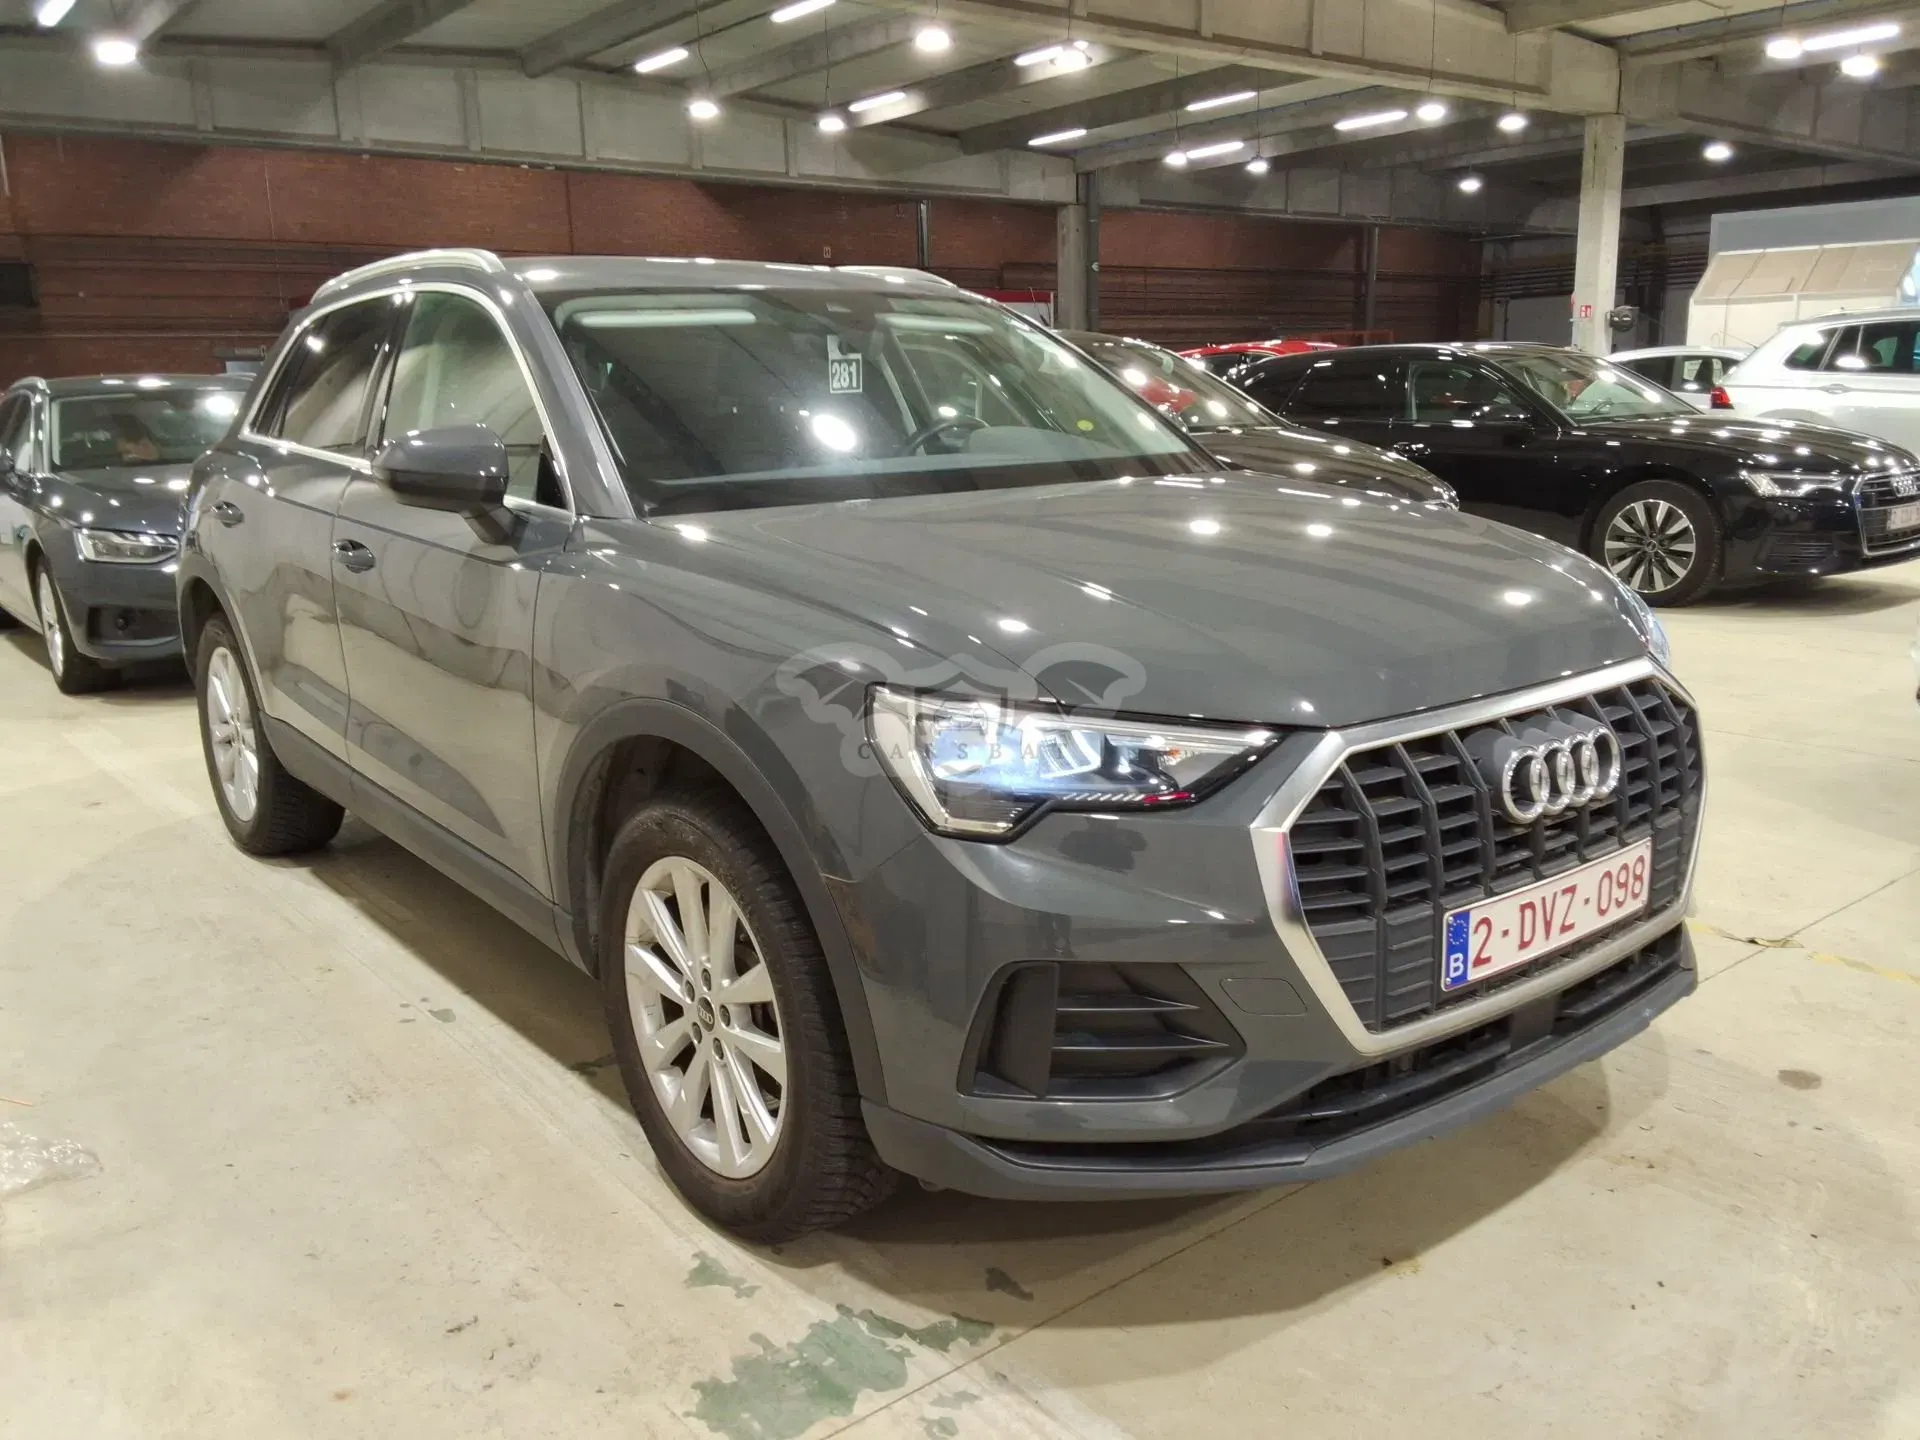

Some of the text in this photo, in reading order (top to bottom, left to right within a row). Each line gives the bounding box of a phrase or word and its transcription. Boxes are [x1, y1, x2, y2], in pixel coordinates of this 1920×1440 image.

[832, 361, 857, 389] 281
[1472, 854, 1645, 968] 2-DVZ-098
[1449, 952, 1464, 978] B
